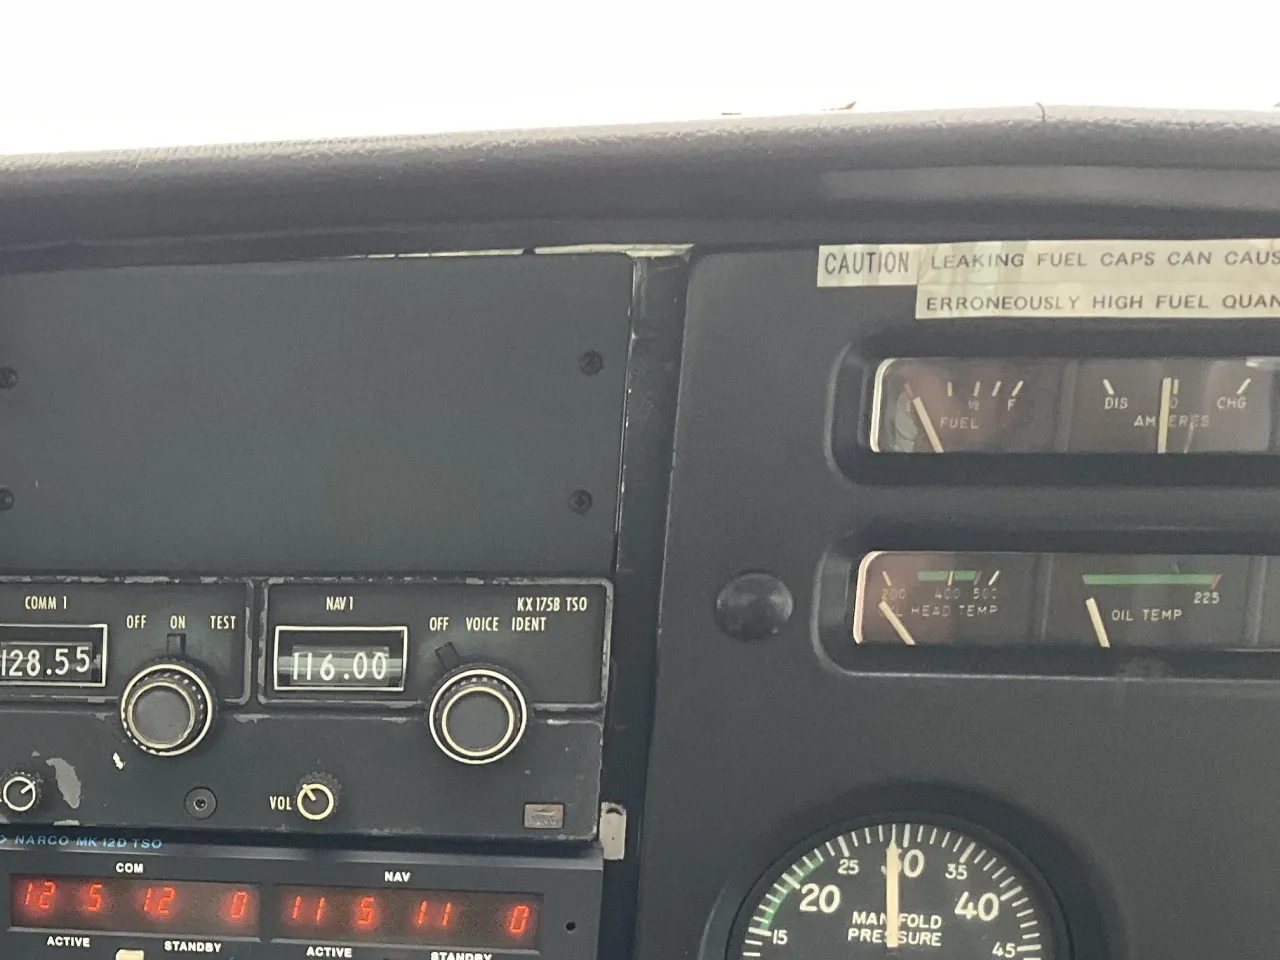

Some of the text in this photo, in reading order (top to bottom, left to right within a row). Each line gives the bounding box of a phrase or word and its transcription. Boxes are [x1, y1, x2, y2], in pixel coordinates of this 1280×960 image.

[824, 251, 910, 275] CAUTION
[931, 250, 1212, 269] LEAKING FUEL CAPS CAN
[926, 293, 1209, 312] ERRONEOUSLY HIGH FUEL
[940, 416, 979, 430] FUEL
[25, 596, 56, 610] COMM
[326, 596, 346, 610] NAV
[517, 597, 532, 611] KX
[566, 597, 587, 611] TSO
[1194, 592, 1220, 604] 225
[1143, 609, 1182, 620] TEMP
[127, 615, 146, 629] OFF
[170, 615, 186, 629] ON
[210, 616, 236, 629] TEST
[429, 617, 449, 631] OFF
[466, 617, 499, 631] VOICE
[511, 617, 546, 631] IDENT
[0, 646, 90, 677] 128.55
[270, 796, 292, 810] VOL
[14, 836, 162, 848] NARCO TSO
[116, 863, 144, 873] COM
[384, 872, 410, 882] NAV
[799, 883, 840, 913] 20
[954, 892, 999, 921] 40
[47, 936, 90, 948] ACTIVE
[164, 941, 221, 952] STANDBY
[306, 947, 352, 958] ACTIVE
